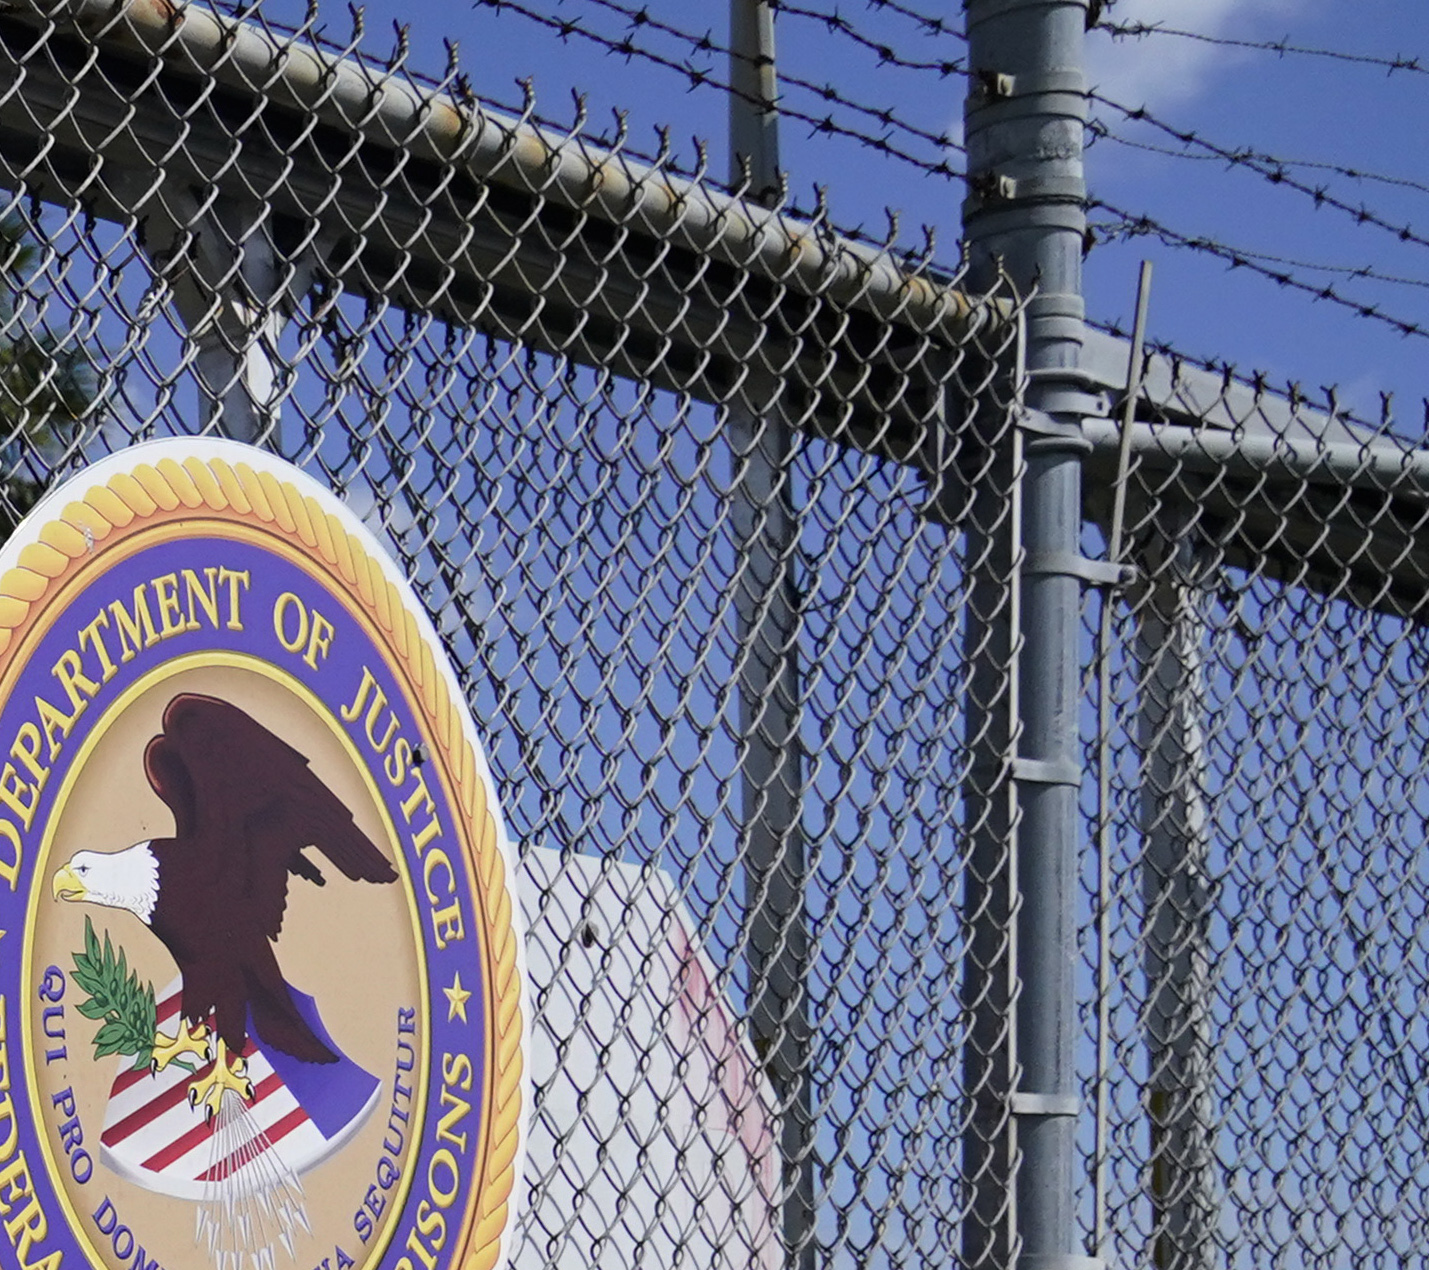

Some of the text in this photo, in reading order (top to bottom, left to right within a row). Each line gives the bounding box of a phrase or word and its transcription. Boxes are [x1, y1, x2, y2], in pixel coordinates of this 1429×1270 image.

[274, 592, 335, 670] OF
[341, 667, 465, 949] JUSTICE
[37, 965, 66, 1066] QUI
[51, 1092, 93, 1186] PRO
[352, 1006, 417, 1244] SEQUITUR
